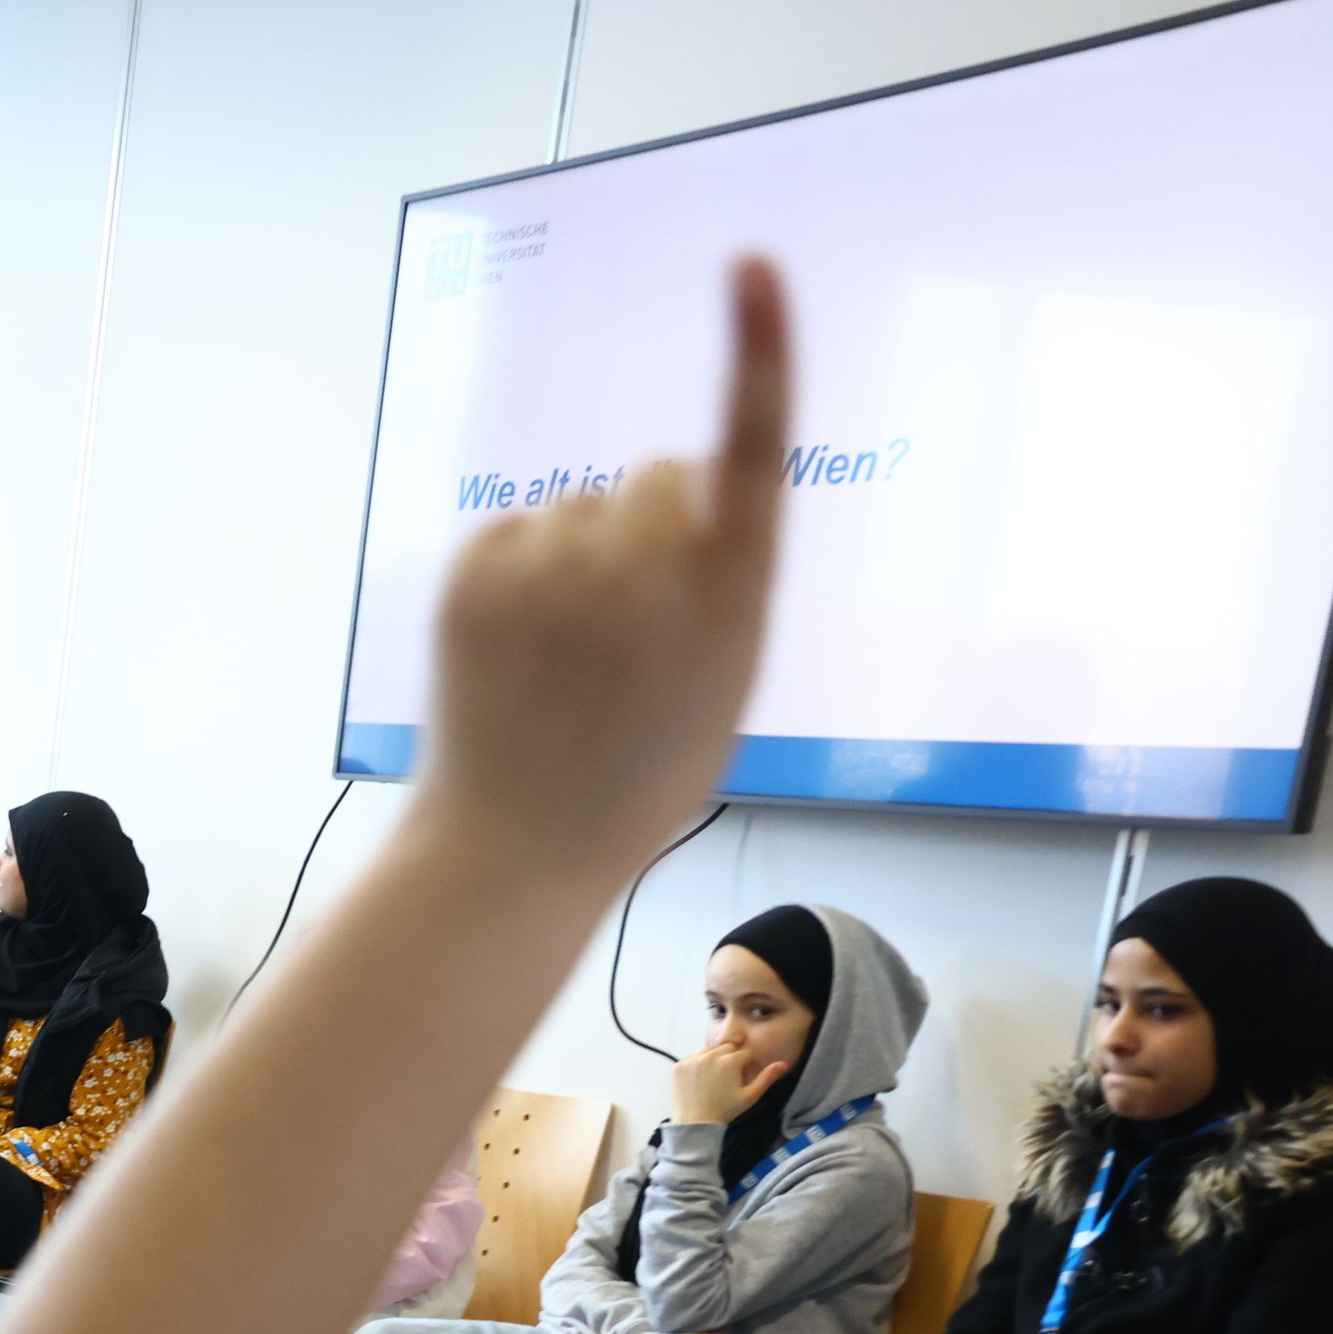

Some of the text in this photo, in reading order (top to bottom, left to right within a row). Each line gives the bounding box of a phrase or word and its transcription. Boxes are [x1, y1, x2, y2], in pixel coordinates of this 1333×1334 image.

[457, 473, 516, 511] Wie
[525, 467, 571, 507] alt
[580, 464, 625, 500] ist
